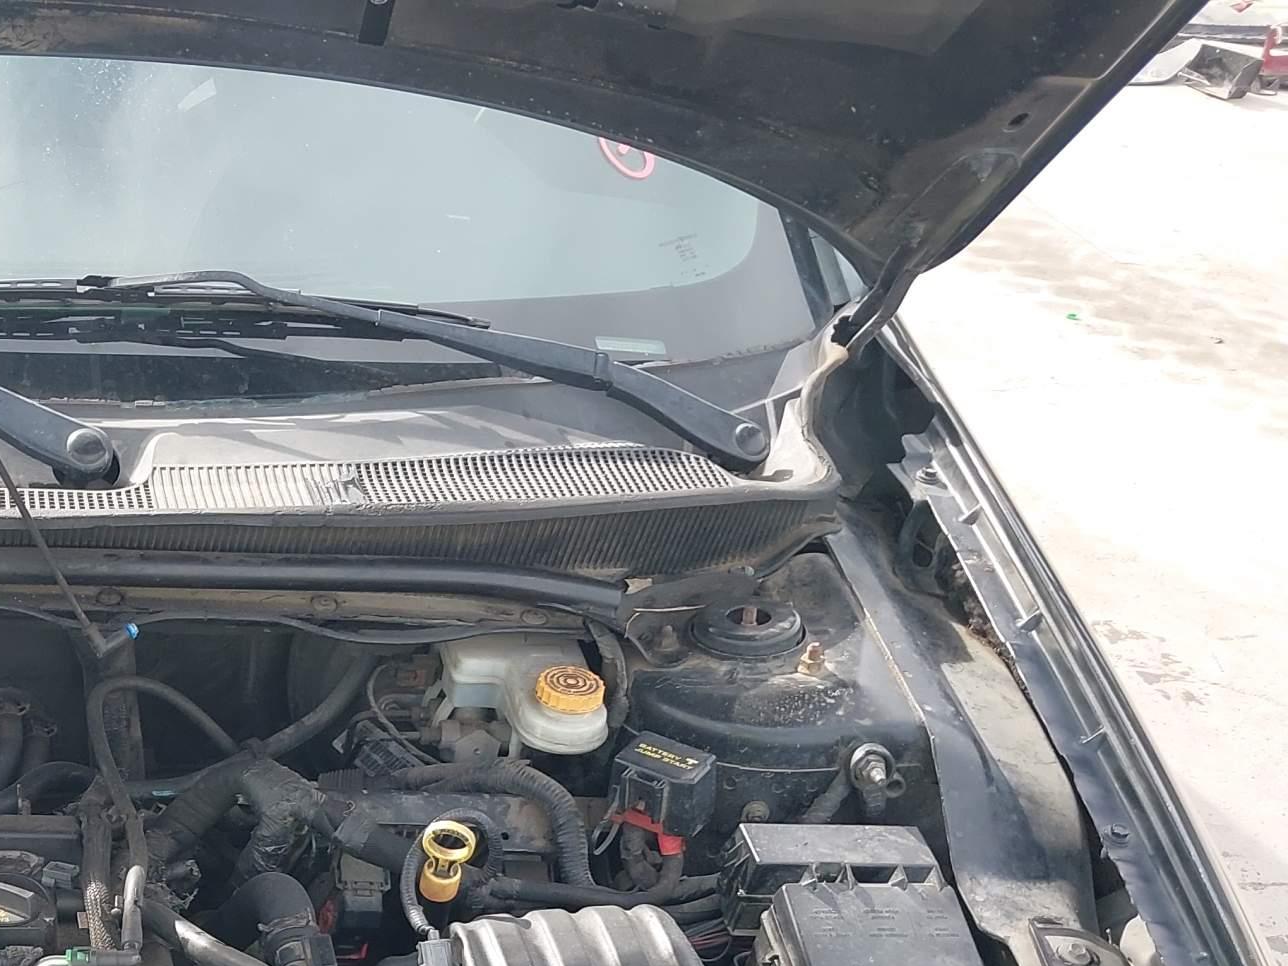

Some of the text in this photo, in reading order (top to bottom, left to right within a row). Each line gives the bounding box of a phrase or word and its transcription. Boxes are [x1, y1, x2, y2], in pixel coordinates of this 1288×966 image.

[634, 748, 694, 770] JUMP START
[638, 743, 682, 760] BATTERY
